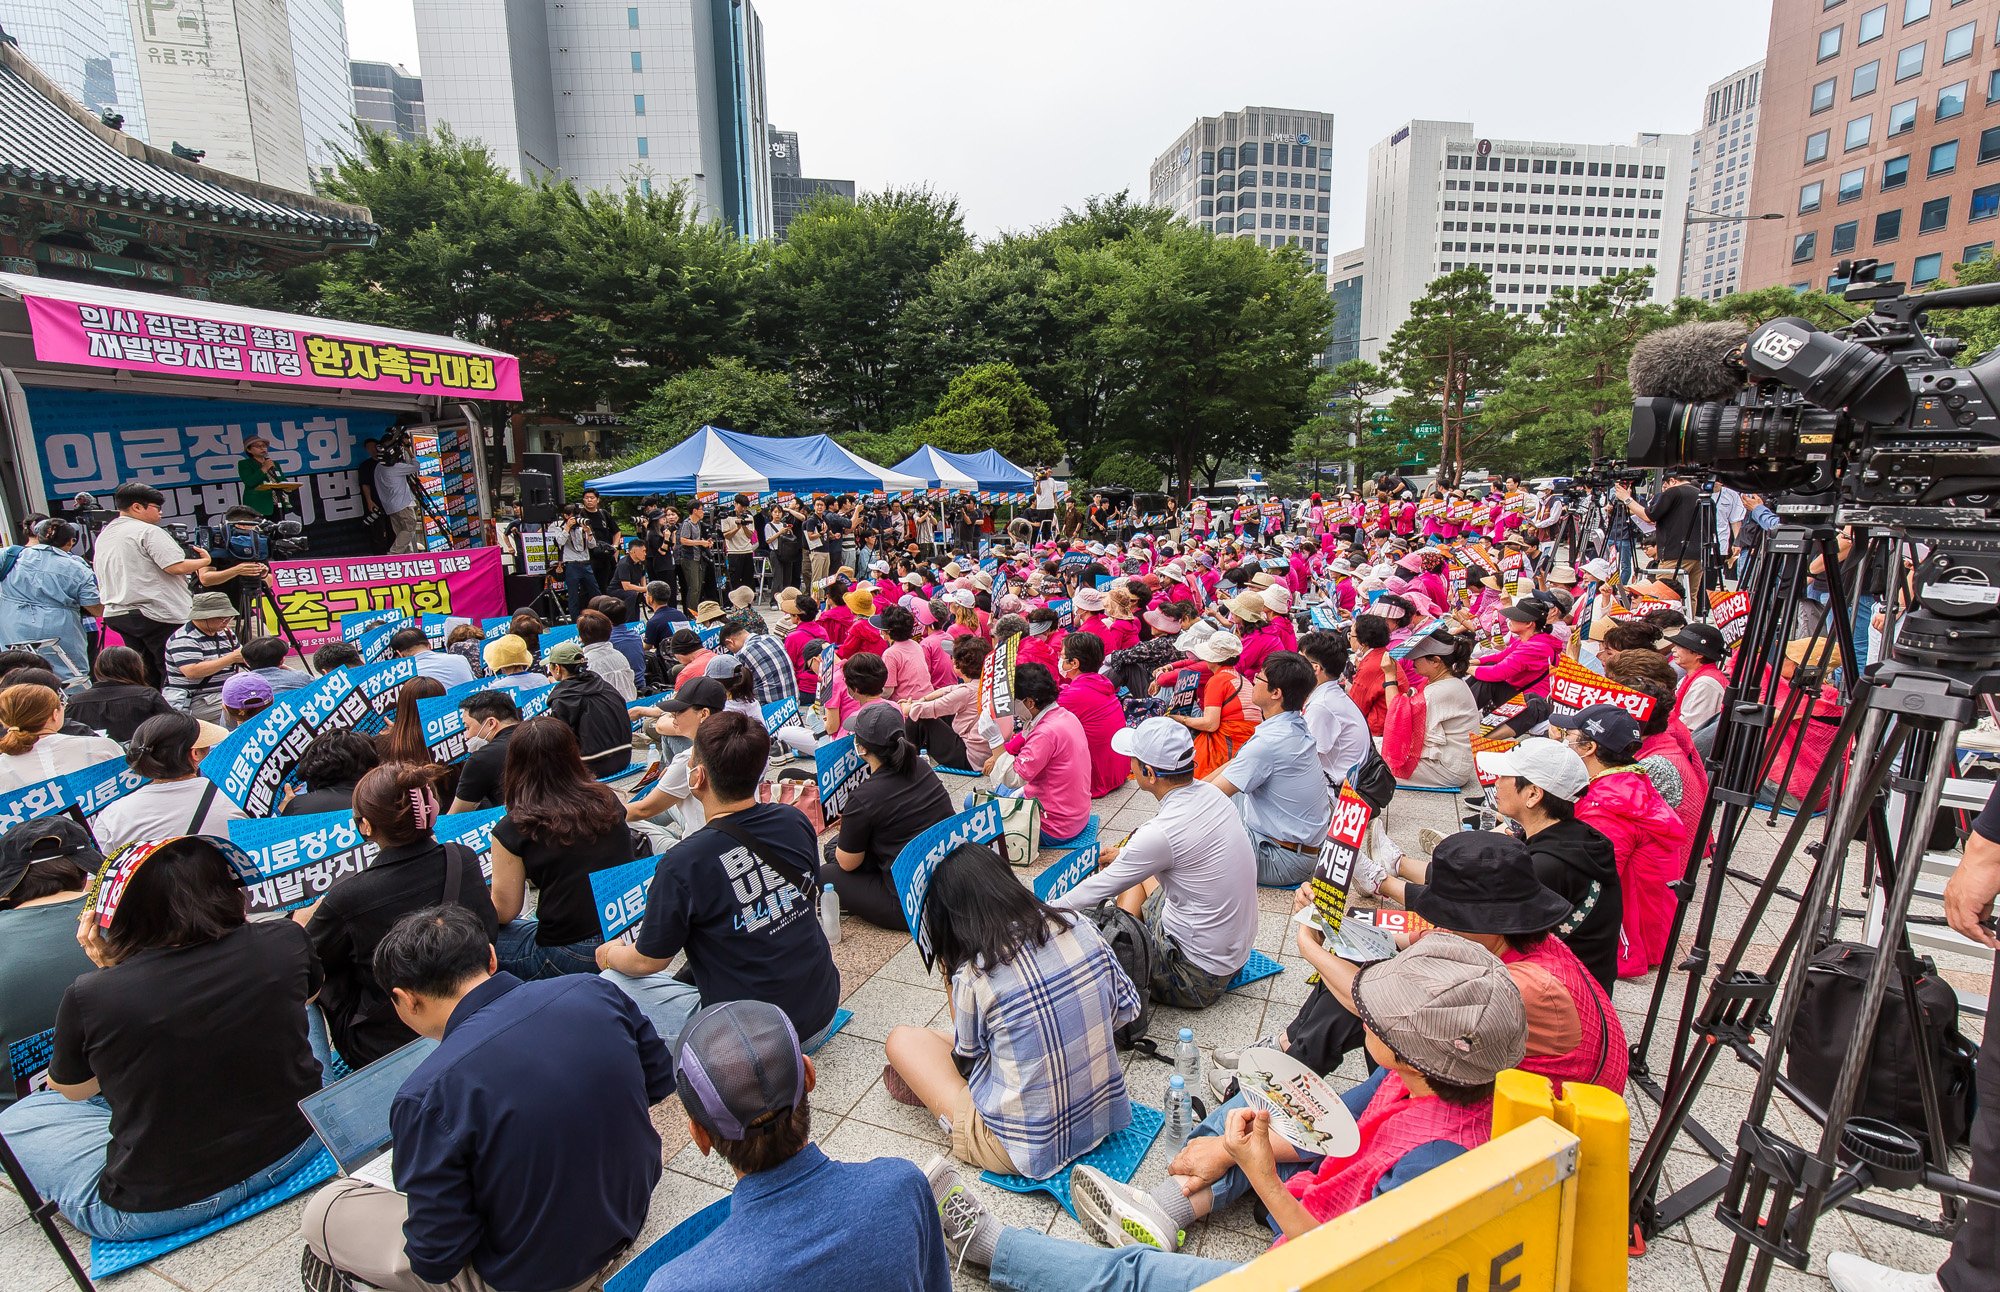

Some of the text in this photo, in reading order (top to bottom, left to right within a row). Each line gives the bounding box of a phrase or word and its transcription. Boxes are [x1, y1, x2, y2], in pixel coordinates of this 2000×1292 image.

[148, 47, 210, 68] 유료주차
[1494, 143, 1576, 157] TOURISM INFORMATION
[78, 305, 298, 352] 의사 집단휴진 철회
[1752, 328, 1805, 363] KBS
[86, 331, 302, 377] 재발방지법 제정
[304, 335, 497, 391] 환자촉구대회
[44, 416, 358, 495] 의료정상화
[275, 556, 471, 588] 철회 및 재발방지법 제정
[327, 636, 343, 644] 10시
[1555, 679, 1650, 718] 의료정상화
[224, 700, 298, 801] 의료정상화
[246, 723, 315, 820] 재발방지법
[247, 818, 357, 874] 의료정상
